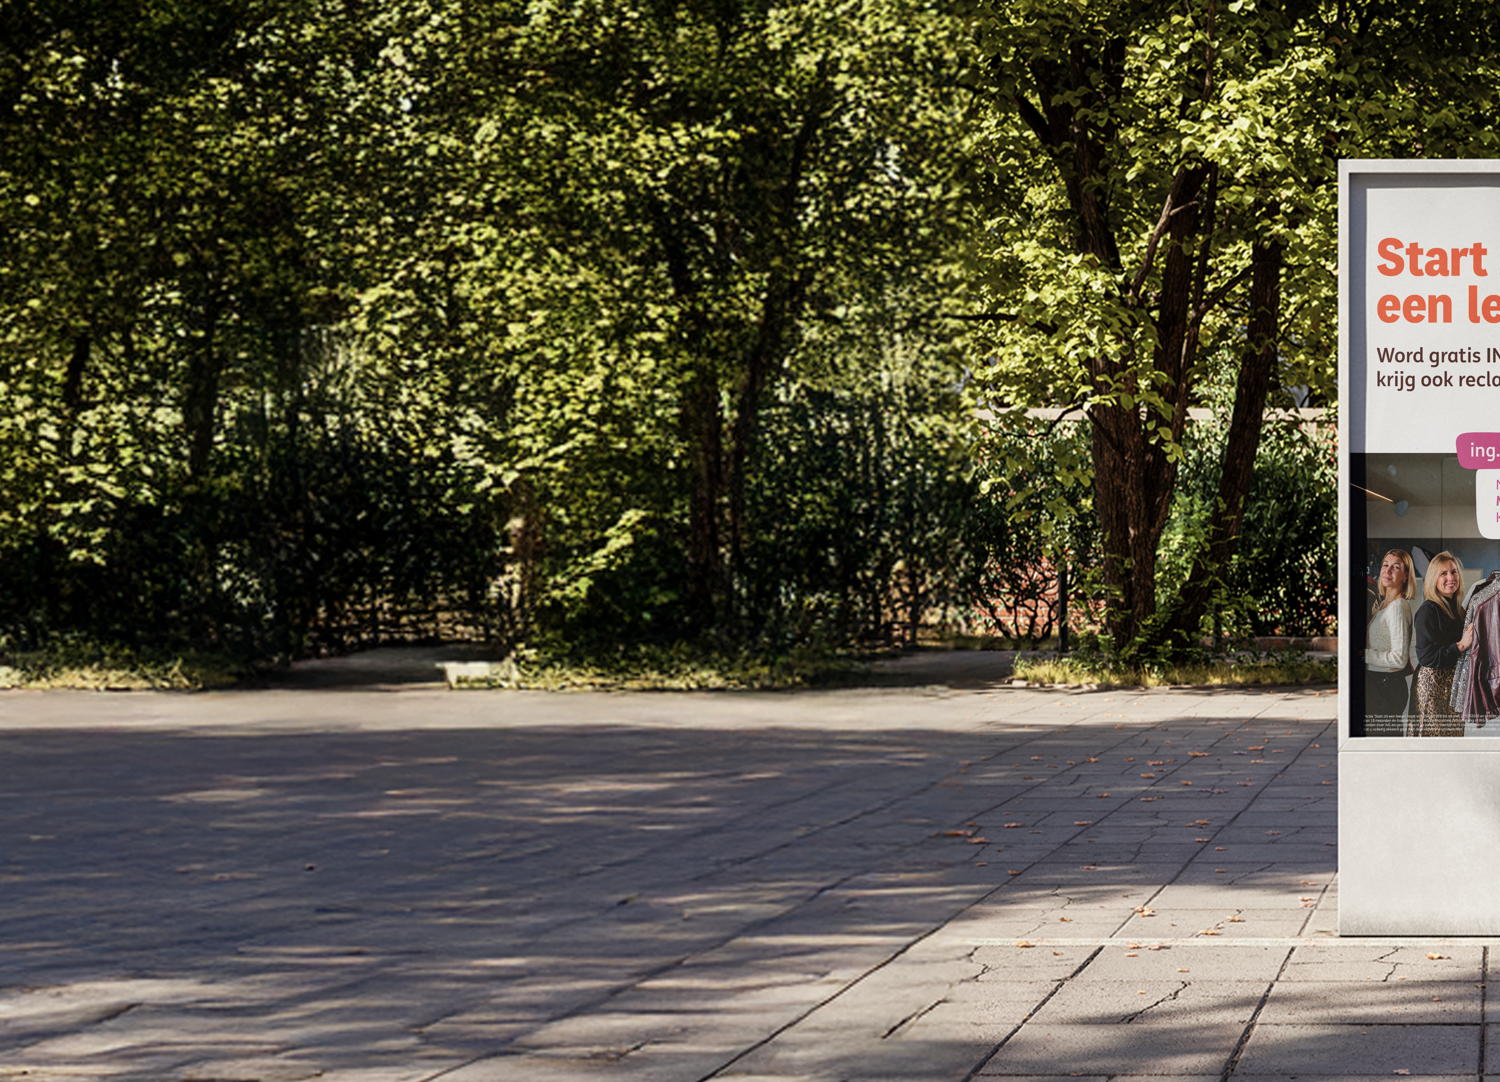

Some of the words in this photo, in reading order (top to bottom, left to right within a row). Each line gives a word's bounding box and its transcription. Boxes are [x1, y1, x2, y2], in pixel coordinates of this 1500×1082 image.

[1376, 237, 1488, 277] Start
[1376, 294, 1453, 324] een
[1376, 347, 1424, 364] Word
[1429, 347, 1481, 367] gratis
[1376, 371, 1415, 392] krijg
[1421, 371, 1453, 387] ook
